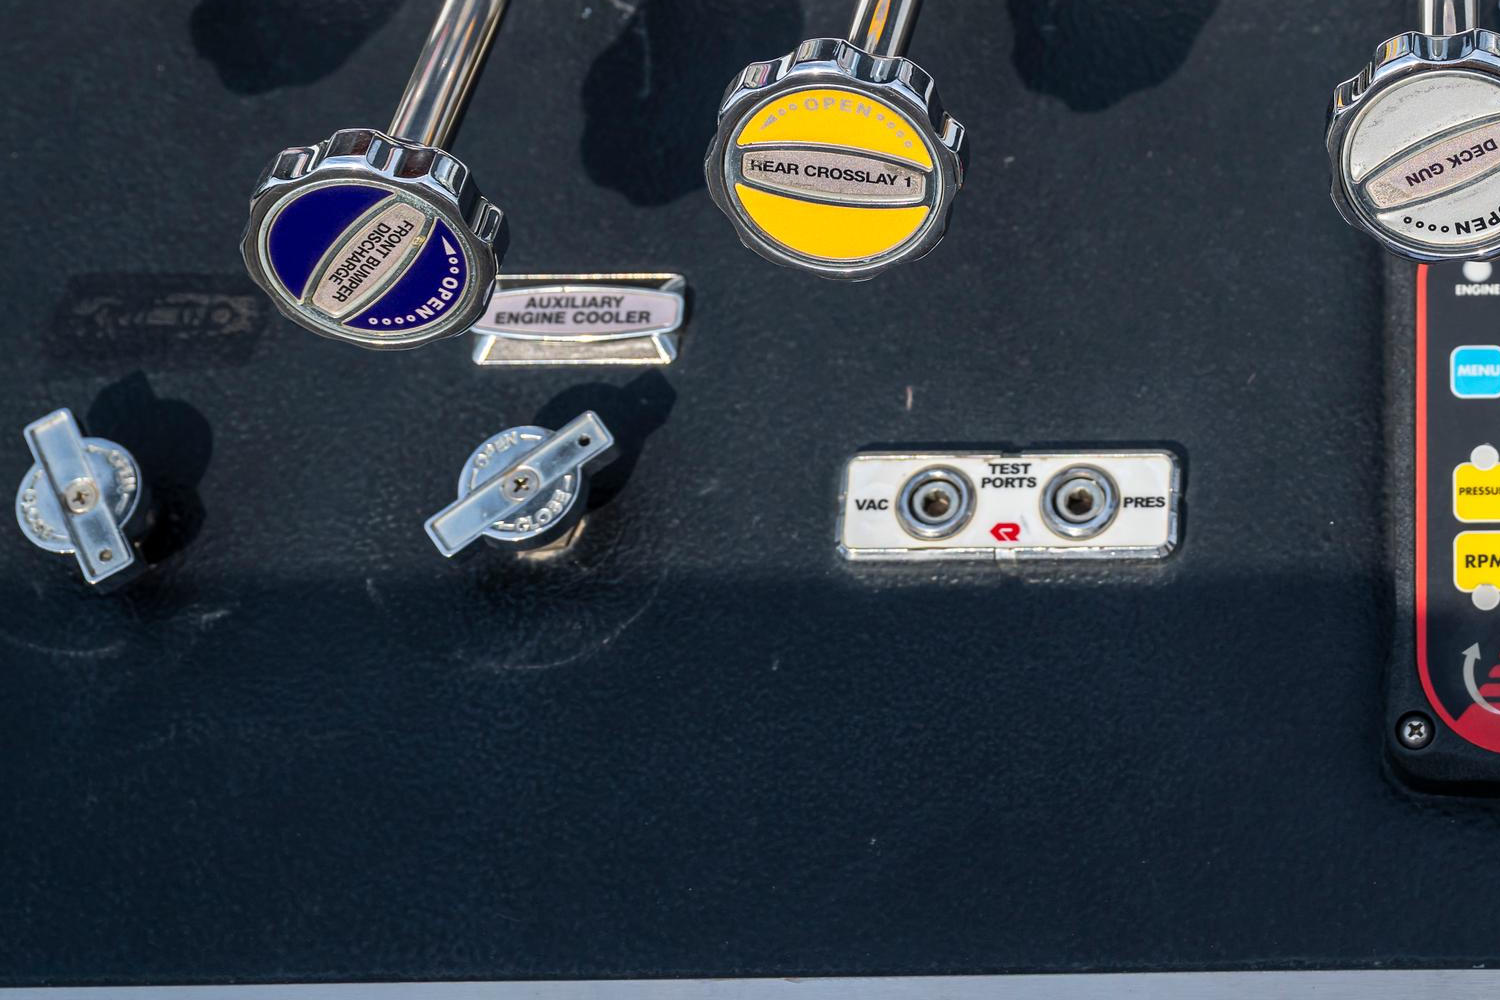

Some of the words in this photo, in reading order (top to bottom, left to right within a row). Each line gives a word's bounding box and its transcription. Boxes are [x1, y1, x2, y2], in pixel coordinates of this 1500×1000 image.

[804, 96, 873, 119] OPEN
[1447, 138, 1499, 169] DECK
[751, 159, 800, 176] REAR
[803, 165, 898, 187] CROSSLAY
[903, 176, 912, 188] 1
[1405, 164, 1445, 188] GUN
[328, 222, 392, 285] DISCHARGE
[376, 220, 414, 261] FRONT
[332, 254, 382, 304] BUMPER
[414, 276, 459, 320] OPEN
[525, 295, 625, 309] AUXILIARY
[494, 310, 566, 325] ENGINE
[572, 310, 652, 324] COOLER
[474, 431, 519, 469] OPEN
[987, 463, 1032, 475] TEST
[981, 477, 1037, 489] PORTS
[514, 489, 573, 533] CLOSE
[855, 499, 889, 511] VAC
[1123, 496, 1166, 509] PRES
